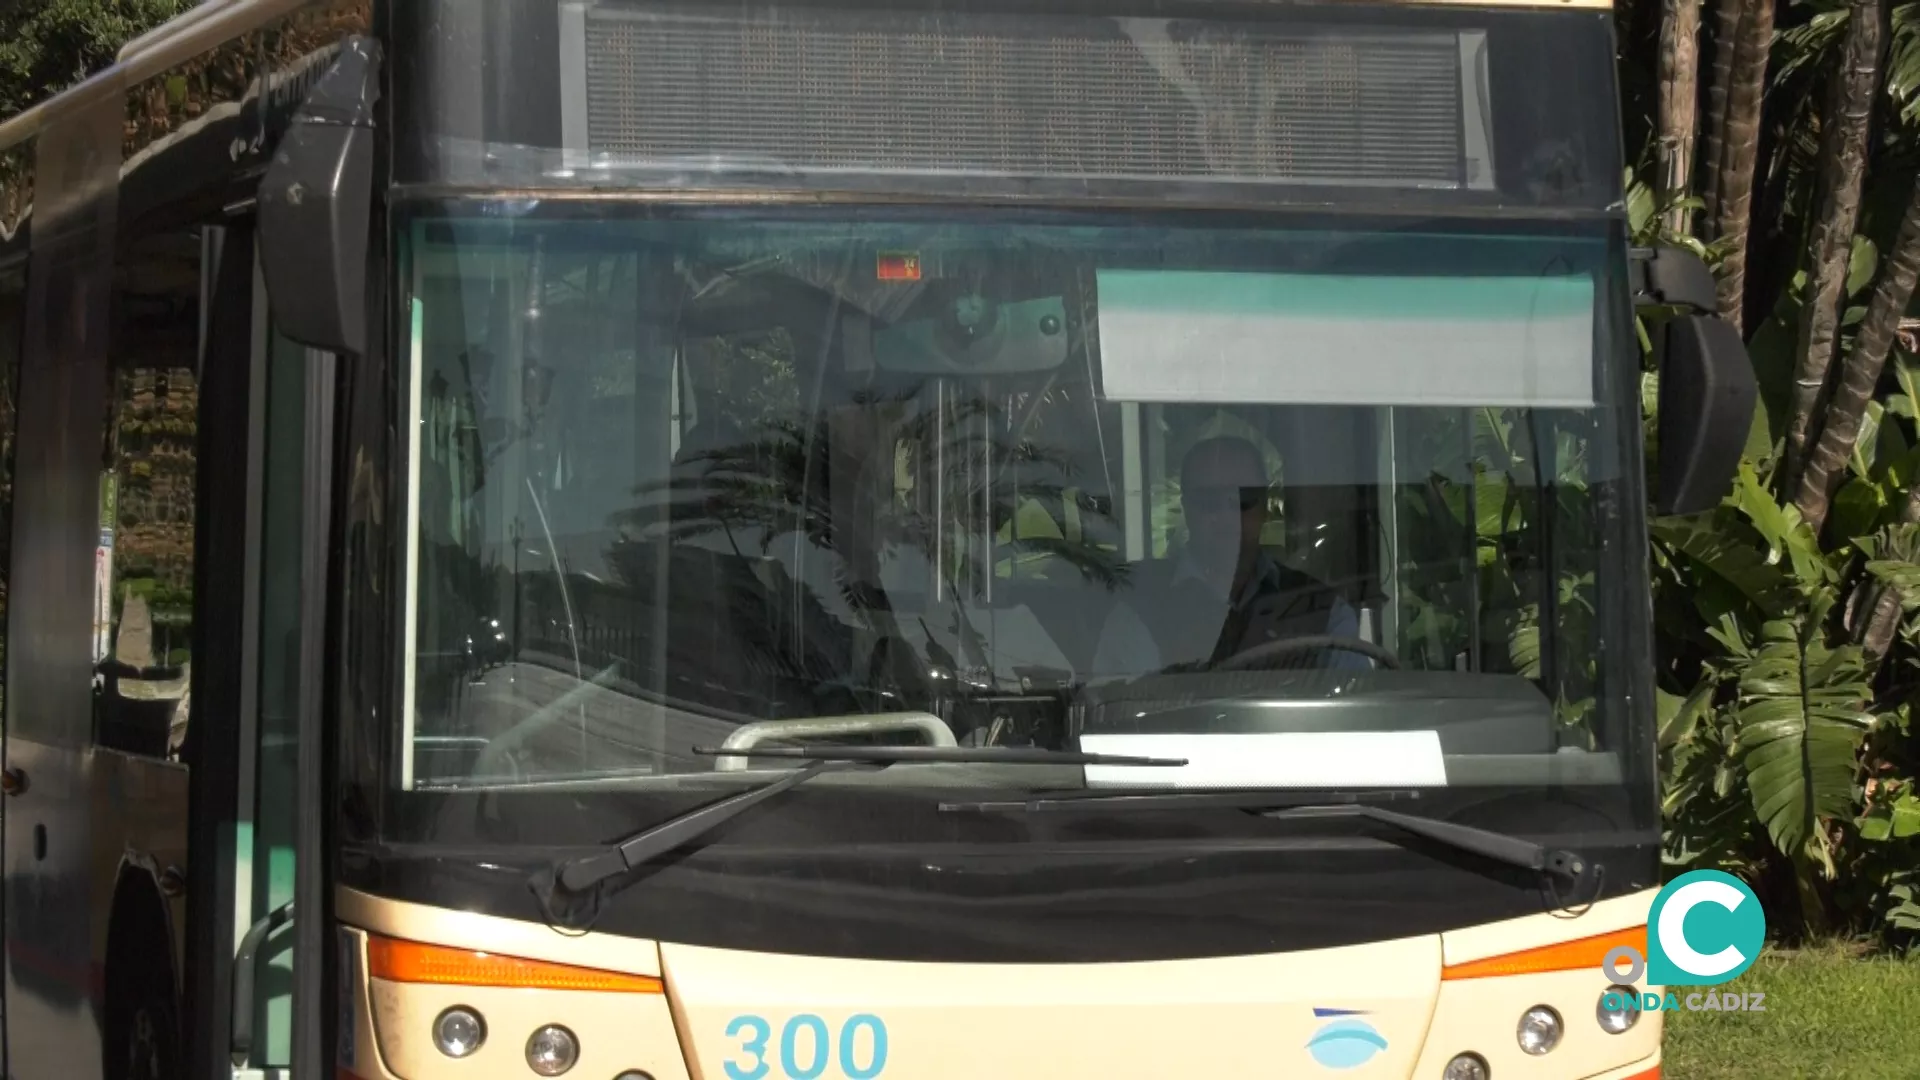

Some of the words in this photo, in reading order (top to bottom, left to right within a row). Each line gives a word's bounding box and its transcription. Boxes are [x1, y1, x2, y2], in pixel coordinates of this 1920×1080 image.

[602, 25, 652, 163] 1
[741, 28, 1008, 99] PLAZA
[1050, 37, 1360, 109] ESPAÑA
[815, 104, 1295, 178] CORTADURA
[723, 1014, 888, 1080] 300
